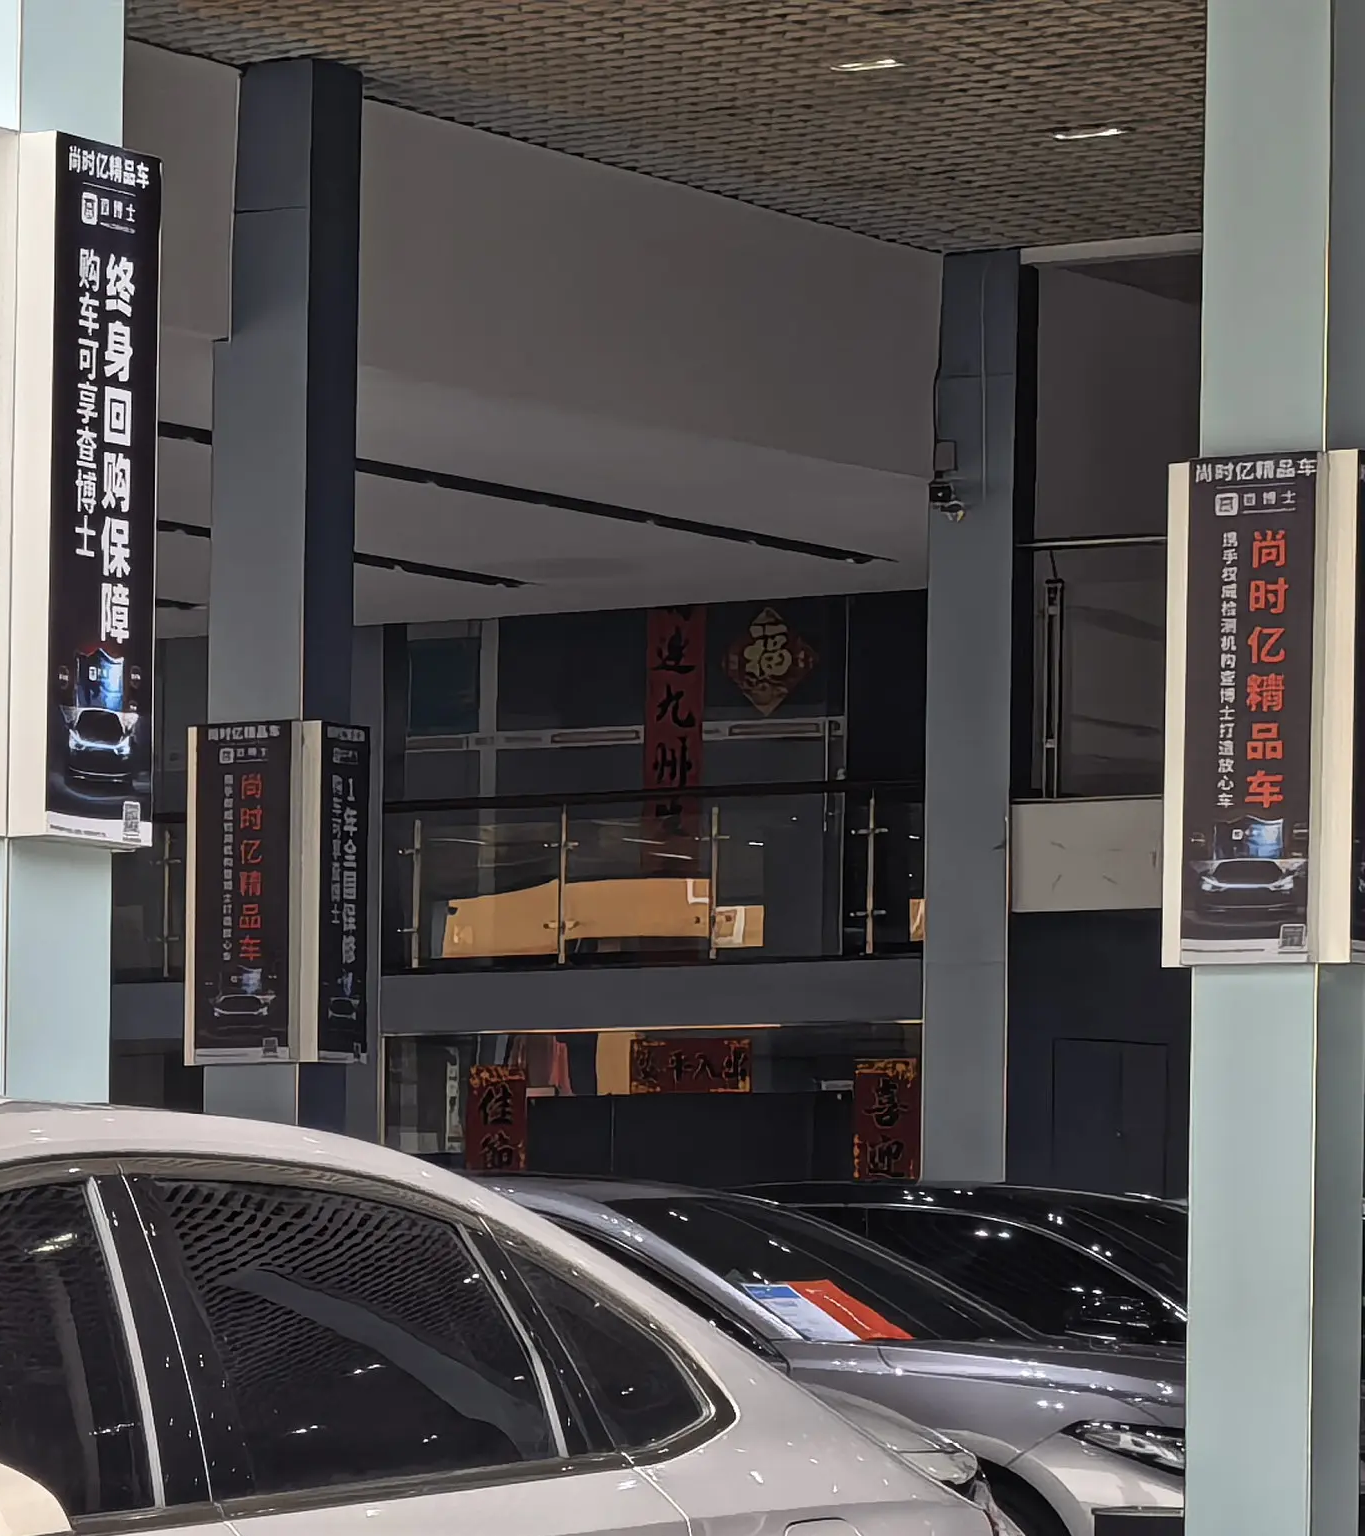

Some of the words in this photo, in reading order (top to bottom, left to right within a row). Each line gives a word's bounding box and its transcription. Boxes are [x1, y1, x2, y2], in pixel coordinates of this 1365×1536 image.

[69, 146, 150, 189] 尚时亿精品车
[75, 248, 100, 558] 购车可享查博士
[100, 253, 135, 644] 终身回购保障
[1244, 530, 1289, 808] 尚时亿精品车
[239, 773, 263, 961] 尚时亿精品车
